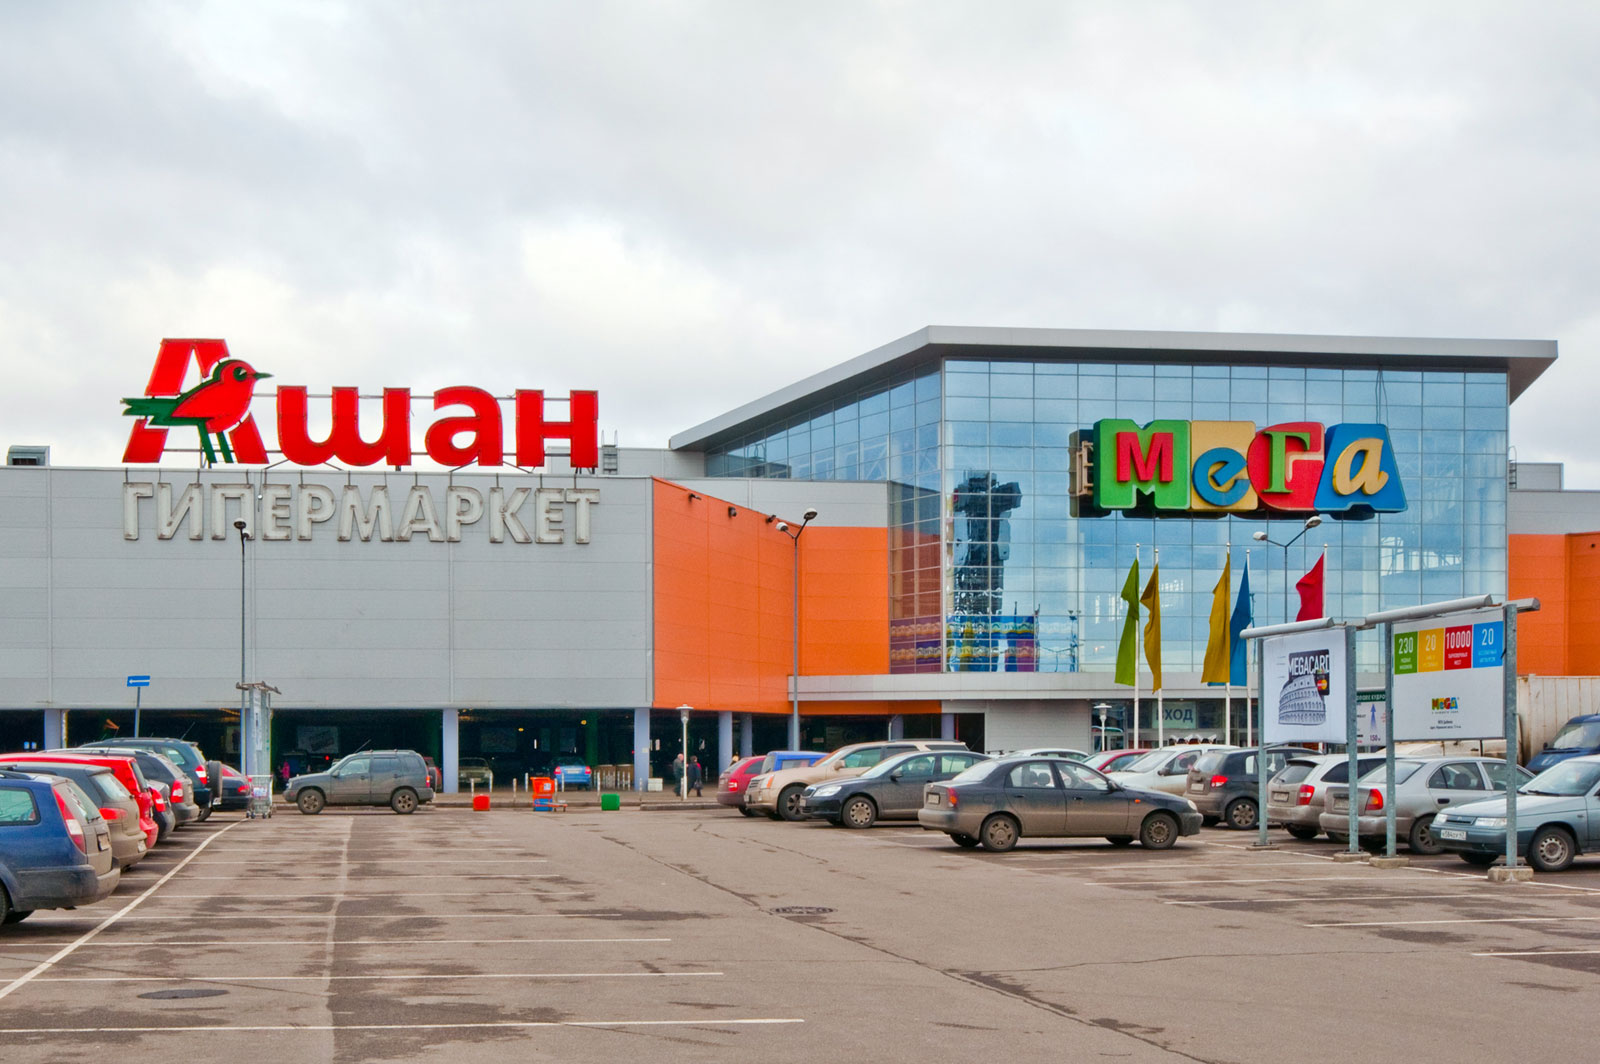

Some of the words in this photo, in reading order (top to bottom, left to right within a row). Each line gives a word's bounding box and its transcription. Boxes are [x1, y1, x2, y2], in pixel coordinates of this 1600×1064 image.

[122, 337, 599, 468] Ашан
[122, 482, 600, 545] ГИПЕРМАРКЕТ
[1398, 637, 1414, 655] 230
[1425, 634, 1437, 652] 20
[1445, 630, 1471, 649] 10000
[1481, 628, 1494, 646] 20
[1288, 654, 1330, 676] MEGACARD
